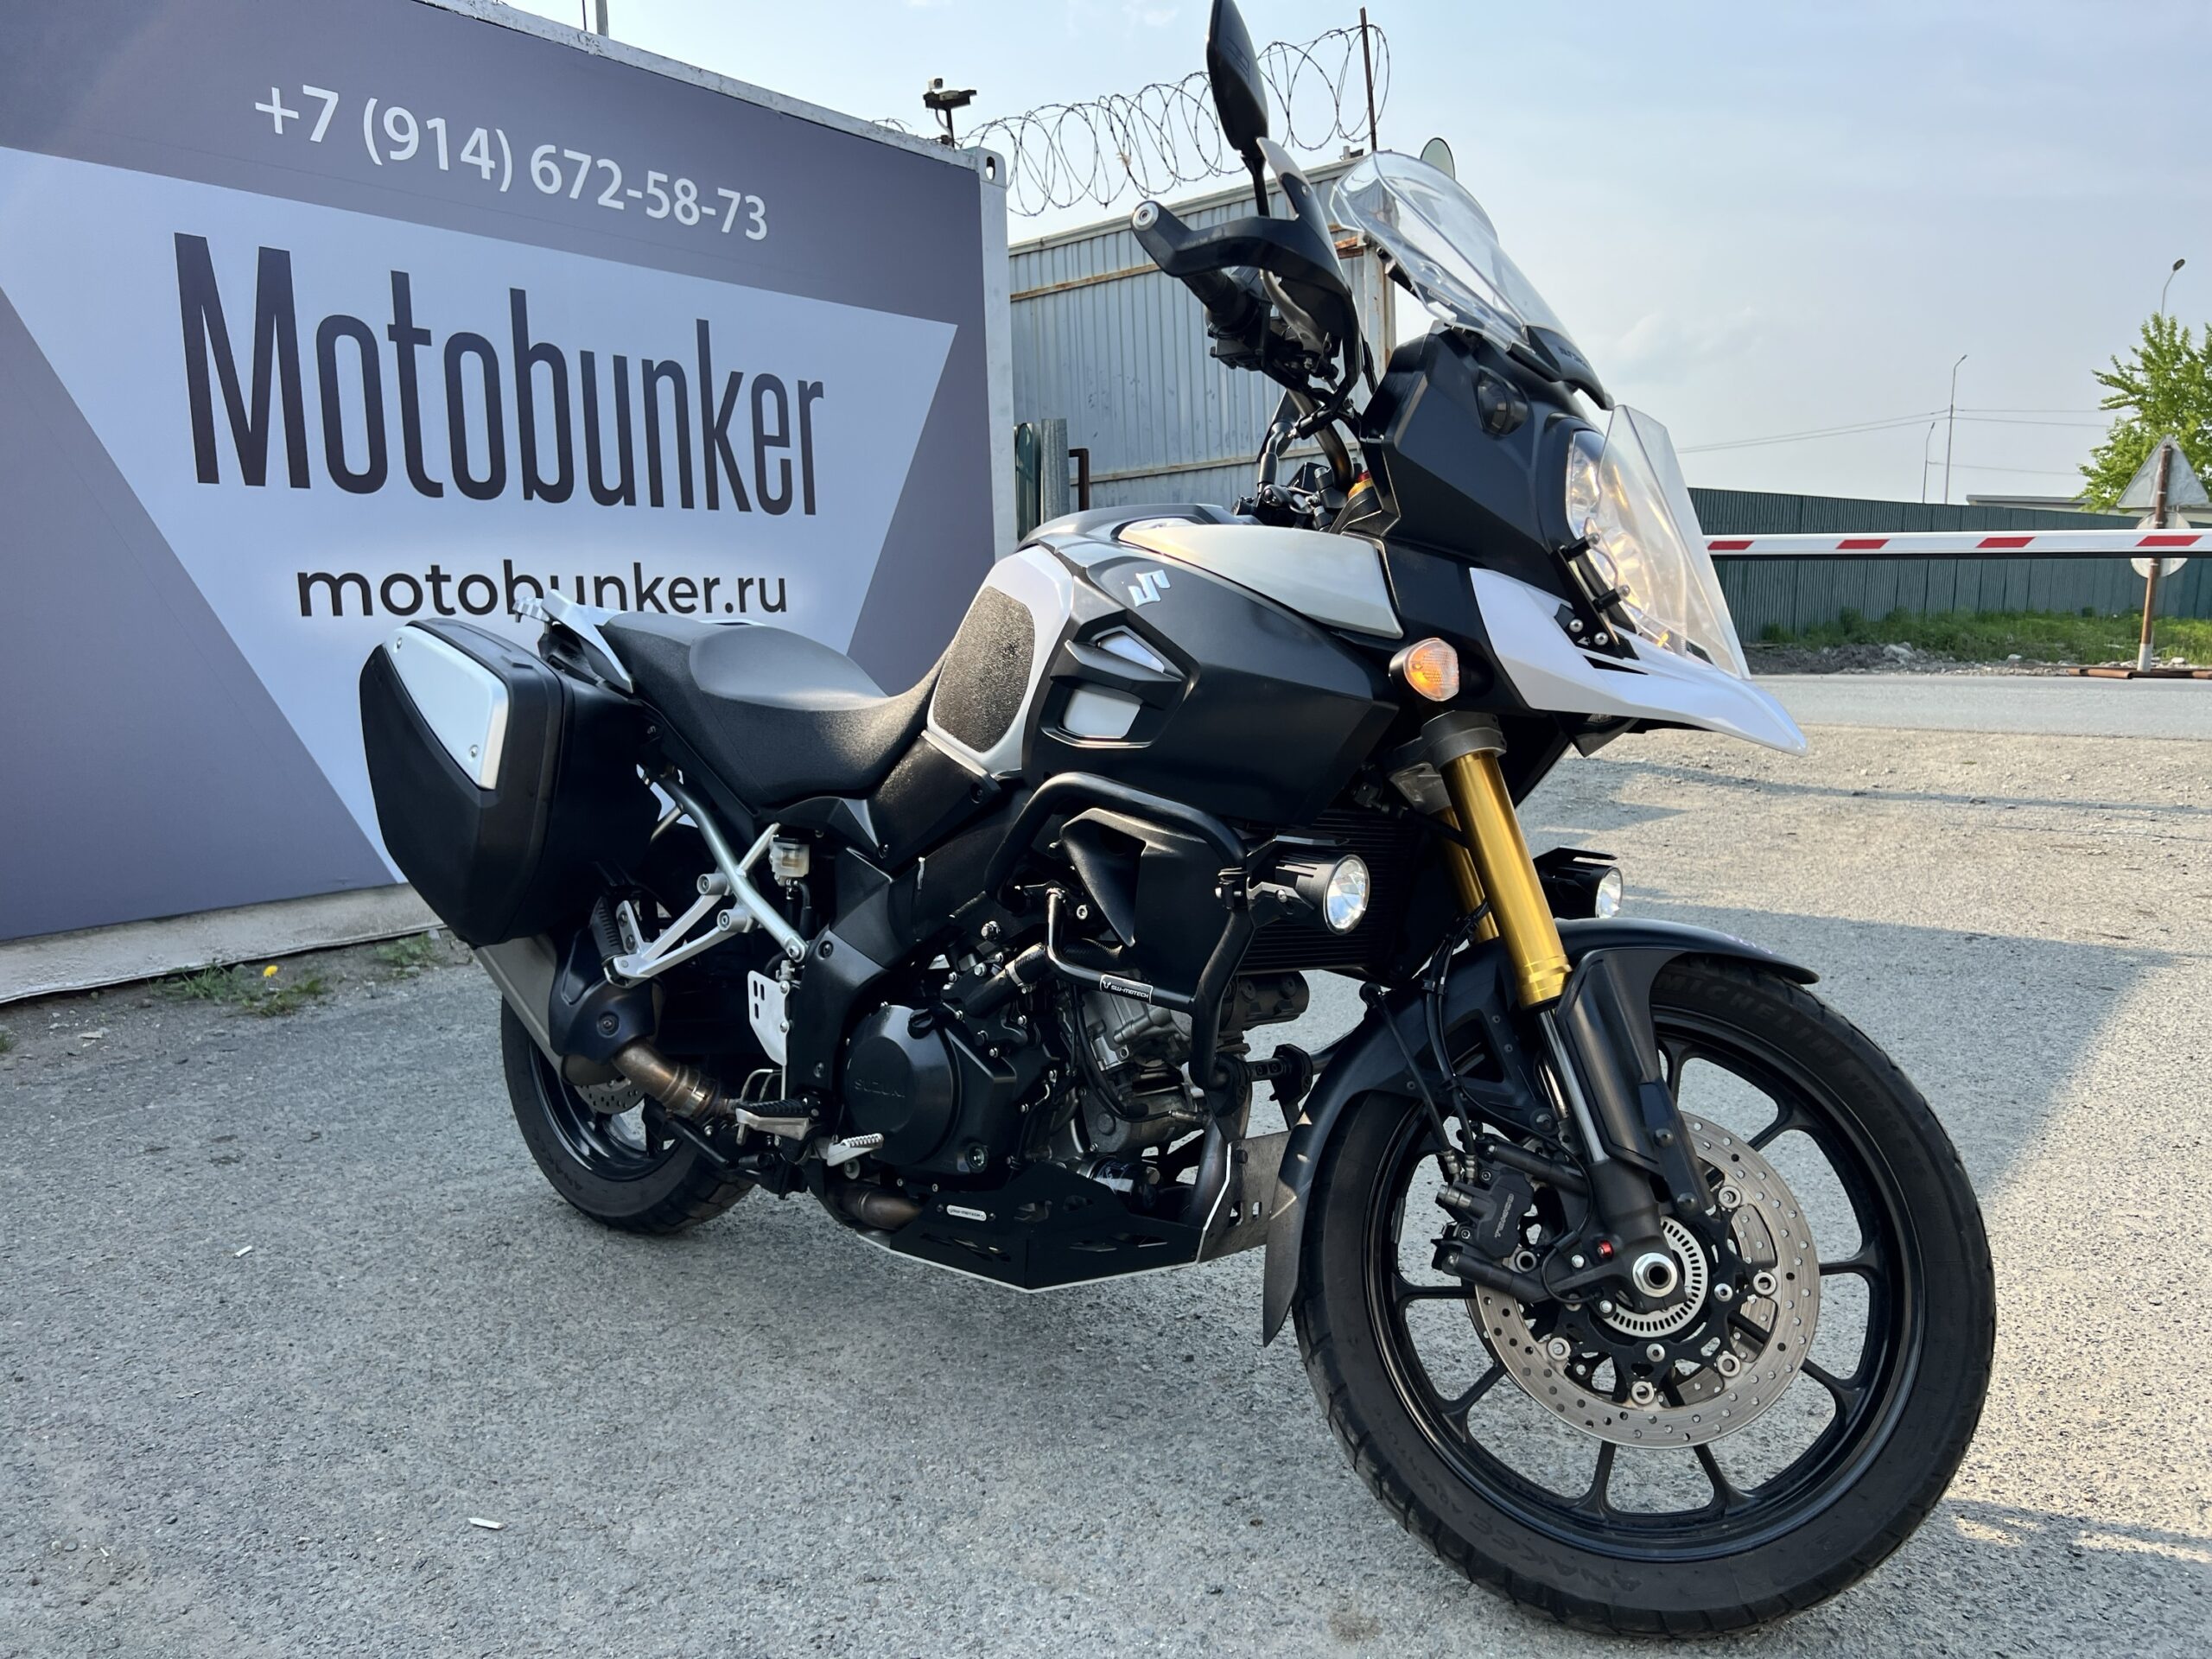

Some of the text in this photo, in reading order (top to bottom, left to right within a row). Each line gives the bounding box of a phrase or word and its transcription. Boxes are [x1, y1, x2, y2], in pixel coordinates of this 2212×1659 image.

[255, 85, 767, 240] +7 (914) 672-58-73
[174, 232, 824, 516] Motobunker
[297, 559, 787, 616] motobunker.ru
[1661, 974, 1840, 1064] MICHELIN
